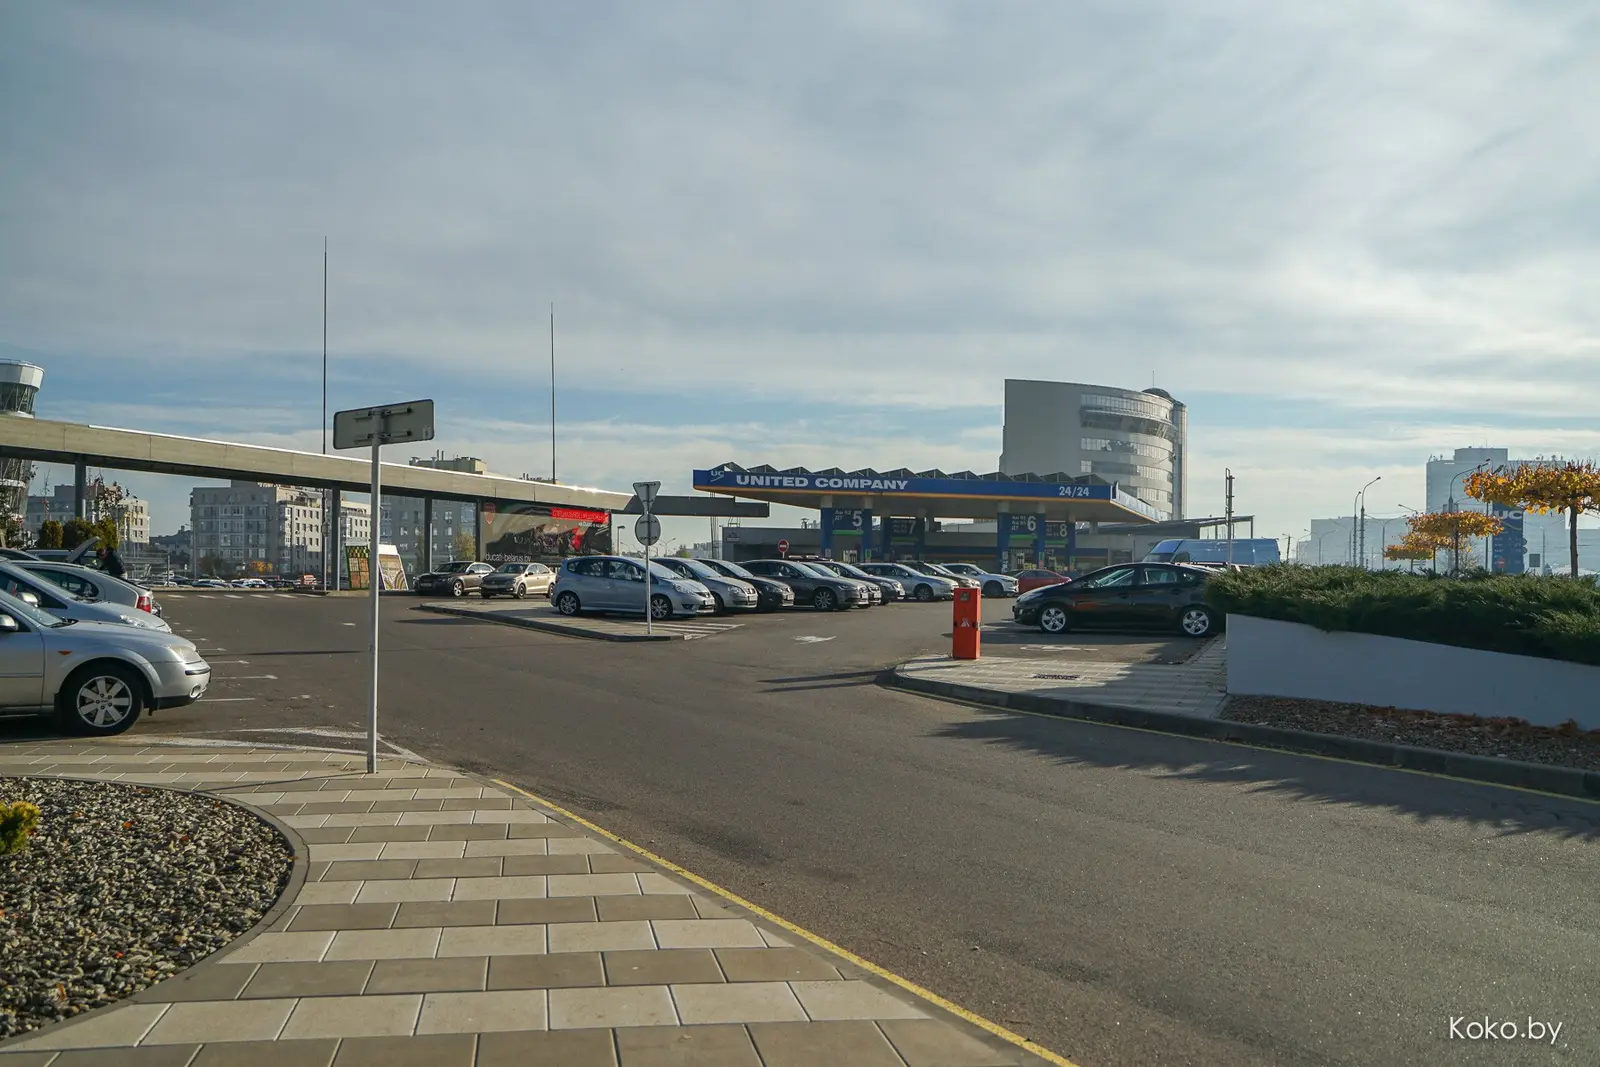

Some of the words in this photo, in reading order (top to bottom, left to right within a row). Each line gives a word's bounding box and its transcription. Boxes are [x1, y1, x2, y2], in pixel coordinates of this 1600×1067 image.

[711, 470, 725, 478] UC
[736, 474, 809, 487] UNITED
[814, 477, 909, 490] COMPANY
[1059, 486, 1090, 498] 24/24
[852, 510, 863, 527] 5
[1494, 510, 1522, 520] UC
[908, 520, 917, 535] 7
[1027, 515, 1037, 531] 6
[1060, 523, 1068, 537] 8
